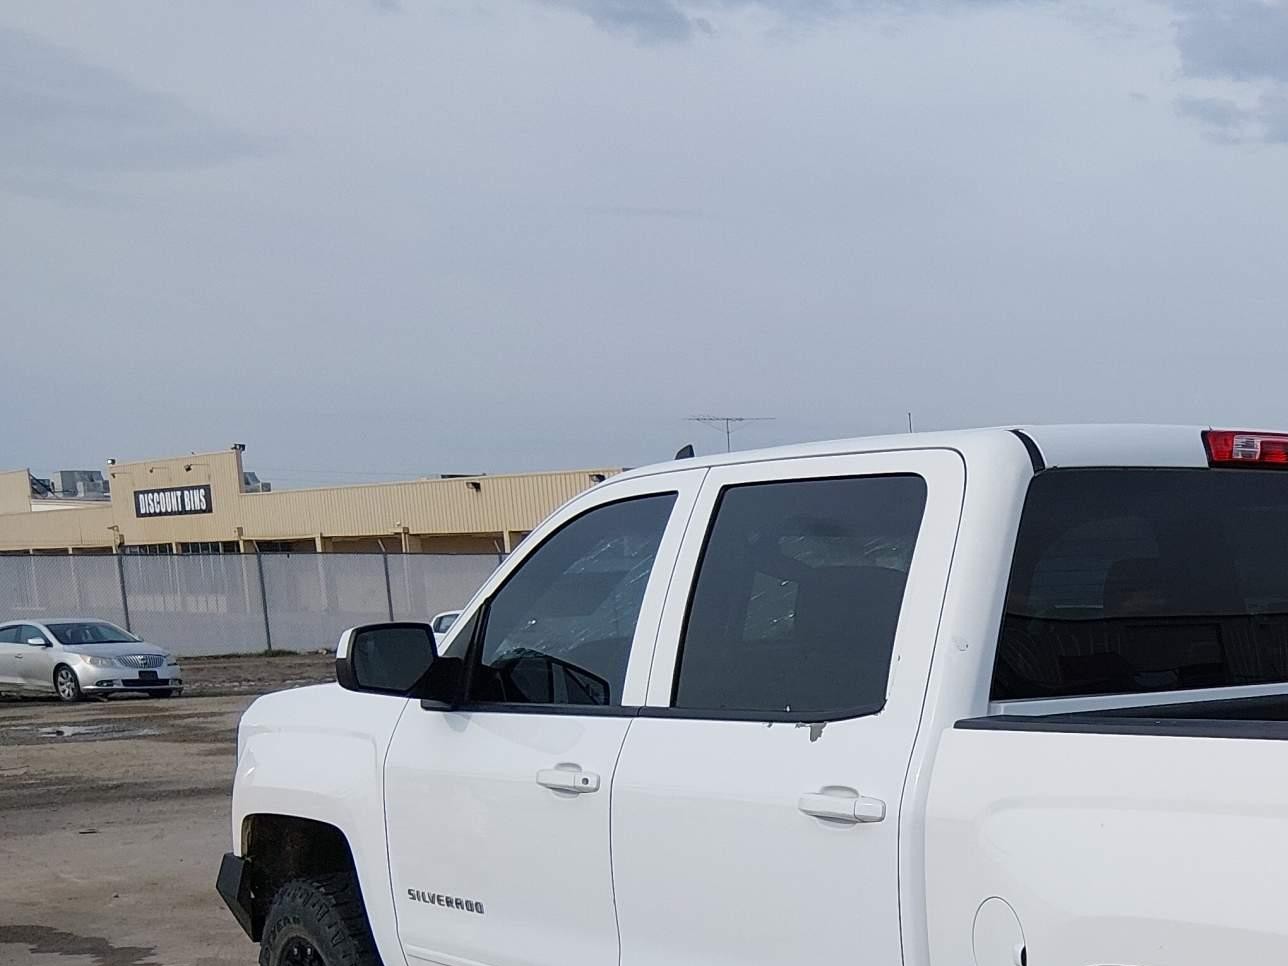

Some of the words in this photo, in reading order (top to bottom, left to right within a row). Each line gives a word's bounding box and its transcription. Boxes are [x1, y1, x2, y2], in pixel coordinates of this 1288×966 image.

[138, 490, 182, 514] DISCOUNT
[183, 488, 207, 511] BINS
[407, 888, 485, 914] SILVERADO
